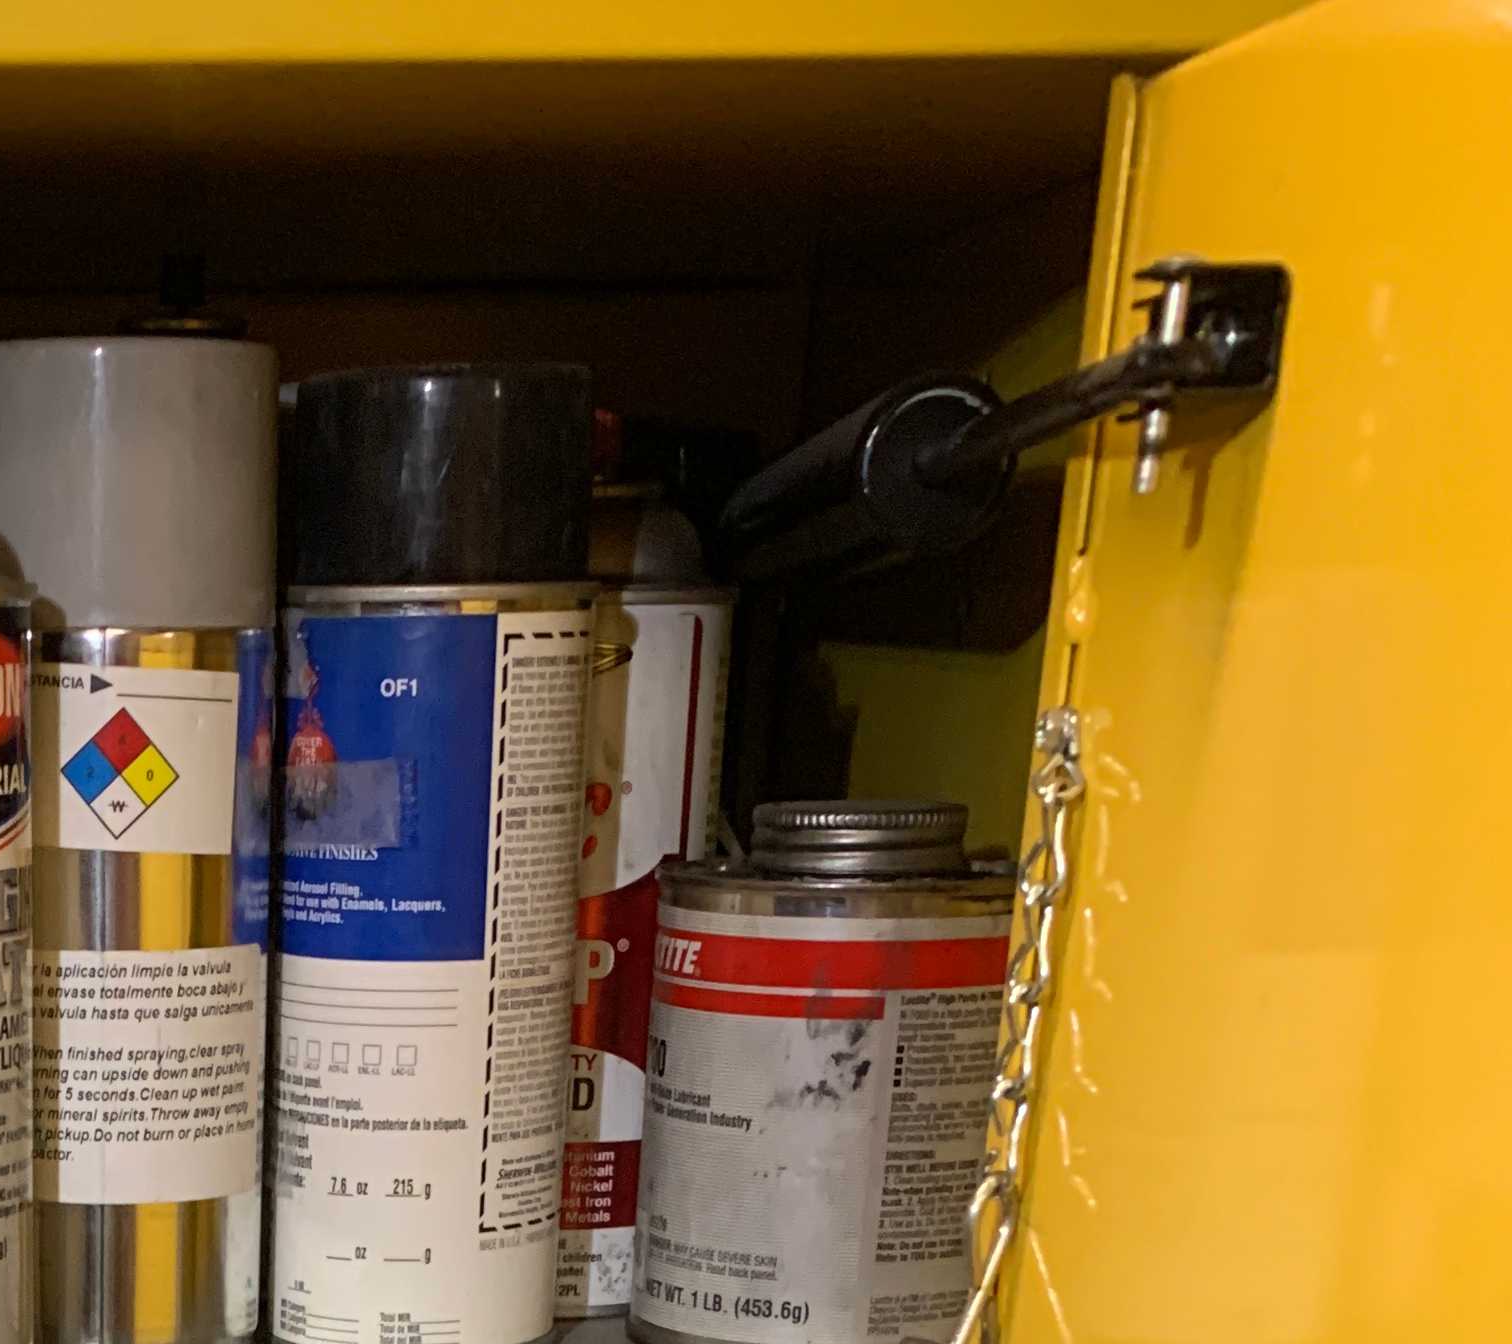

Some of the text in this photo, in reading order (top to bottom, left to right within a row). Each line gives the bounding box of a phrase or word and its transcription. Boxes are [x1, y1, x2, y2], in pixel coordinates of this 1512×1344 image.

[380, 678, 418, 697] OF1
[391, 898, 446, 914] Lacquers,
[56, 960, 231, 983] aplicación limpie la valvula
[99, 982, 207, 999] totalmente boca
[91, 1004, 198, 1023] hasta que salga
[67, 1047, 122, 1061] finished
[73, 1064, 212, 1084] can upside down and
[140, 1084, 220, 1103] Clean up wet
[47, 1107, 221, 1122] mineral Throw away
[117, 1123, 223, 1141] not burn place
[356, 1178, 414, 1195] oz 215
[355, 1246, 367, 1259] oz
[665, 1286, 686, 1306] WT.
[691, 1291, 697, 1308] 1
[702, 1292, 727, 1314] LB.
[734, 1297, 809, 1325] (453.6g)
